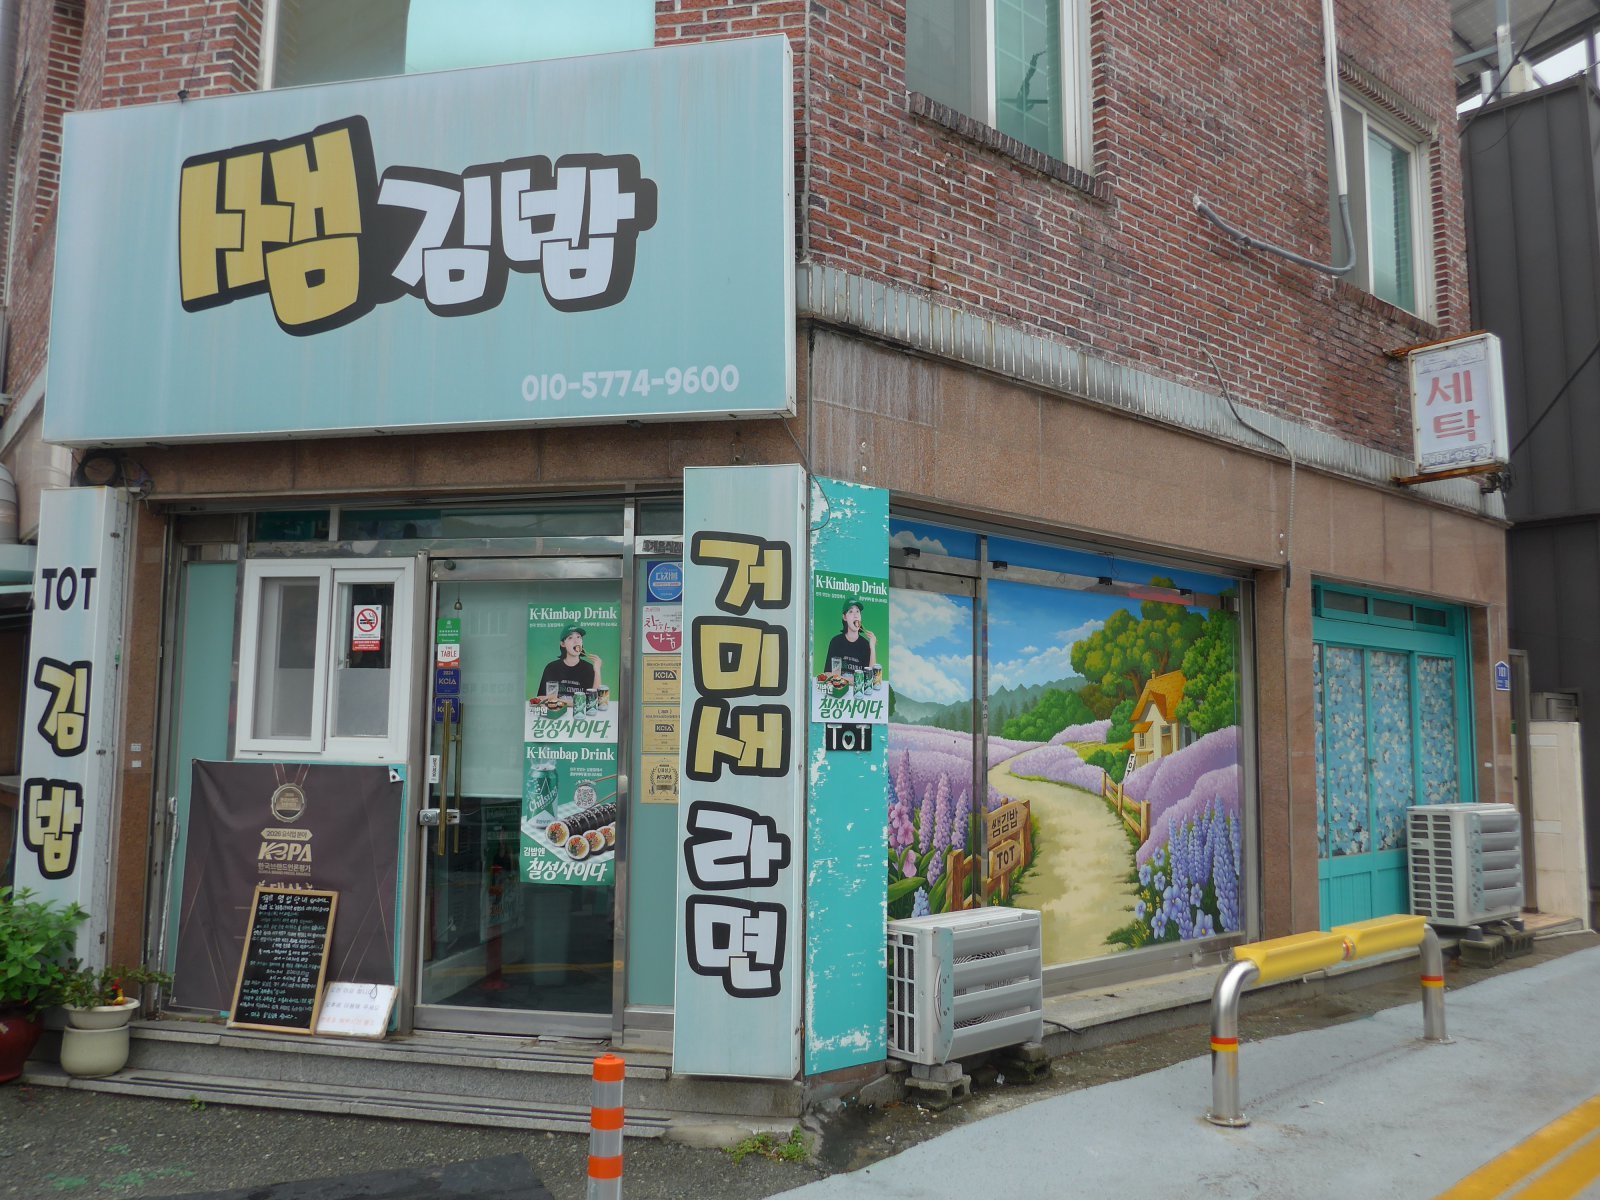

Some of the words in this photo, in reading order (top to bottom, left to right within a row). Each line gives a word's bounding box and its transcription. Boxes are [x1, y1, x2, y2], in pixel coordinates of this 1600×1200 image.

[521, 364, 740, 402] 010-5774-9600
[1426, 369, 1480, 442] 세탁
[41, 567, 97, 611] TOT
[816, 575, 860, 596] K-Kimbap
[862, 580, 888, 596] Drink
[529, 607, 582, 623] K-Kimbap
[584, 606, 617, 620] Drink
[654, 671, 673, 679] KCIA
[818, 694, 884, 720] 칠성사이다
[532, 717, 611, 739] 칠성사이다
[827, 723, 871, 750] TOT
[526, 746, 579, 763] K-Kimbap
[581, 747, 615, 761] Drink
[24, 657, 93, 880] 김밥
[523, 846, 546, 858] 김밥엔
[996, 844, 1015, 870] TOT
[526, 857, 608, 882] 칠성사이다
